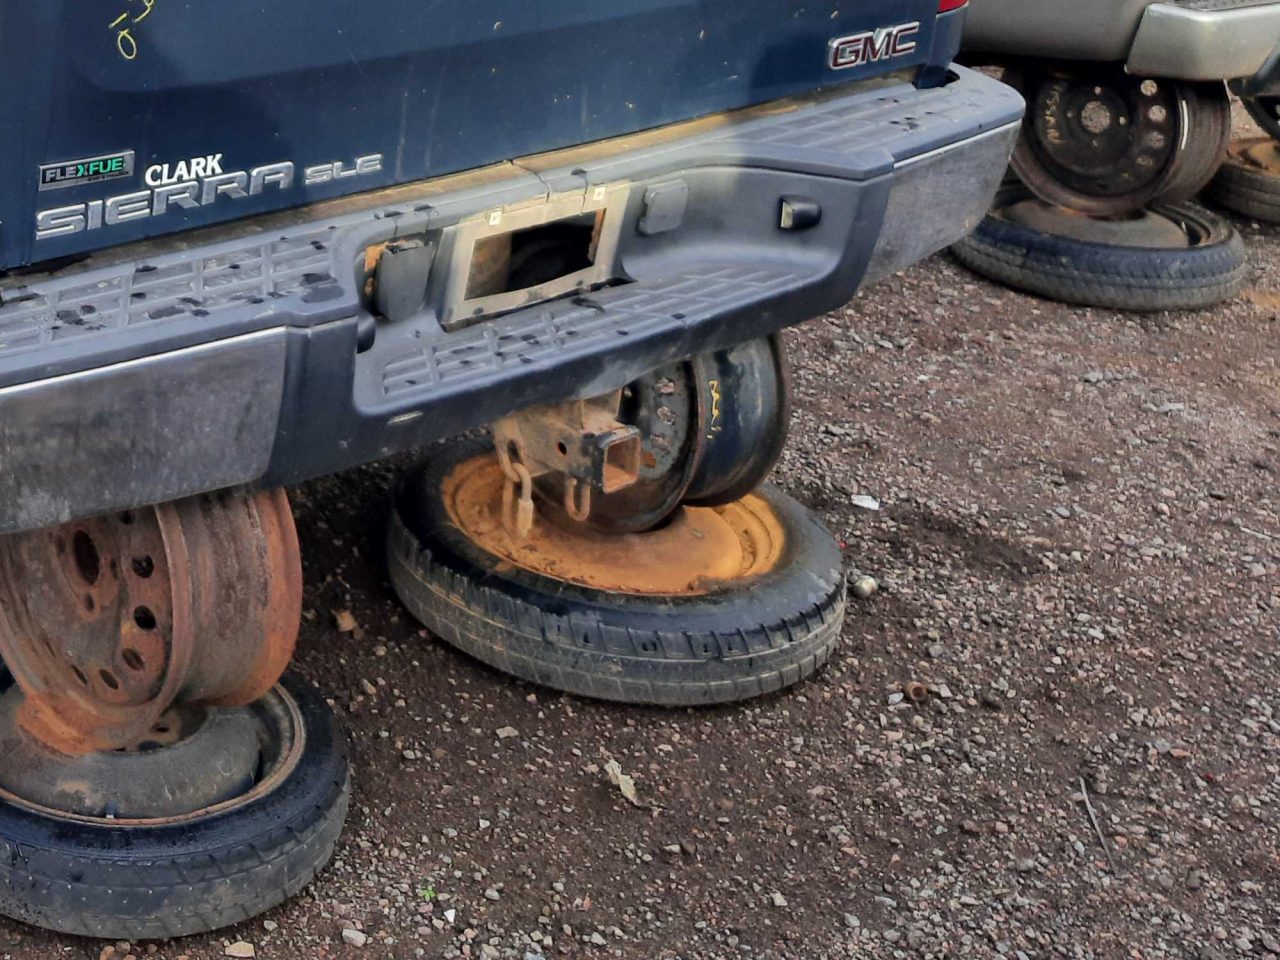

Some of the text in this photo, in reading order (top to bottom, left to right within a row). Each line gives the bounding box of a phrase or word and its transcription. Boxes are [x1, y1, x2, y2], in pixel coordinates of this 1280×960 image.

[828, 21, 920, 70] GMC
[145, 153, 223, 186] CLARK
[36, 153, 383, 240] SIERRA SLE
